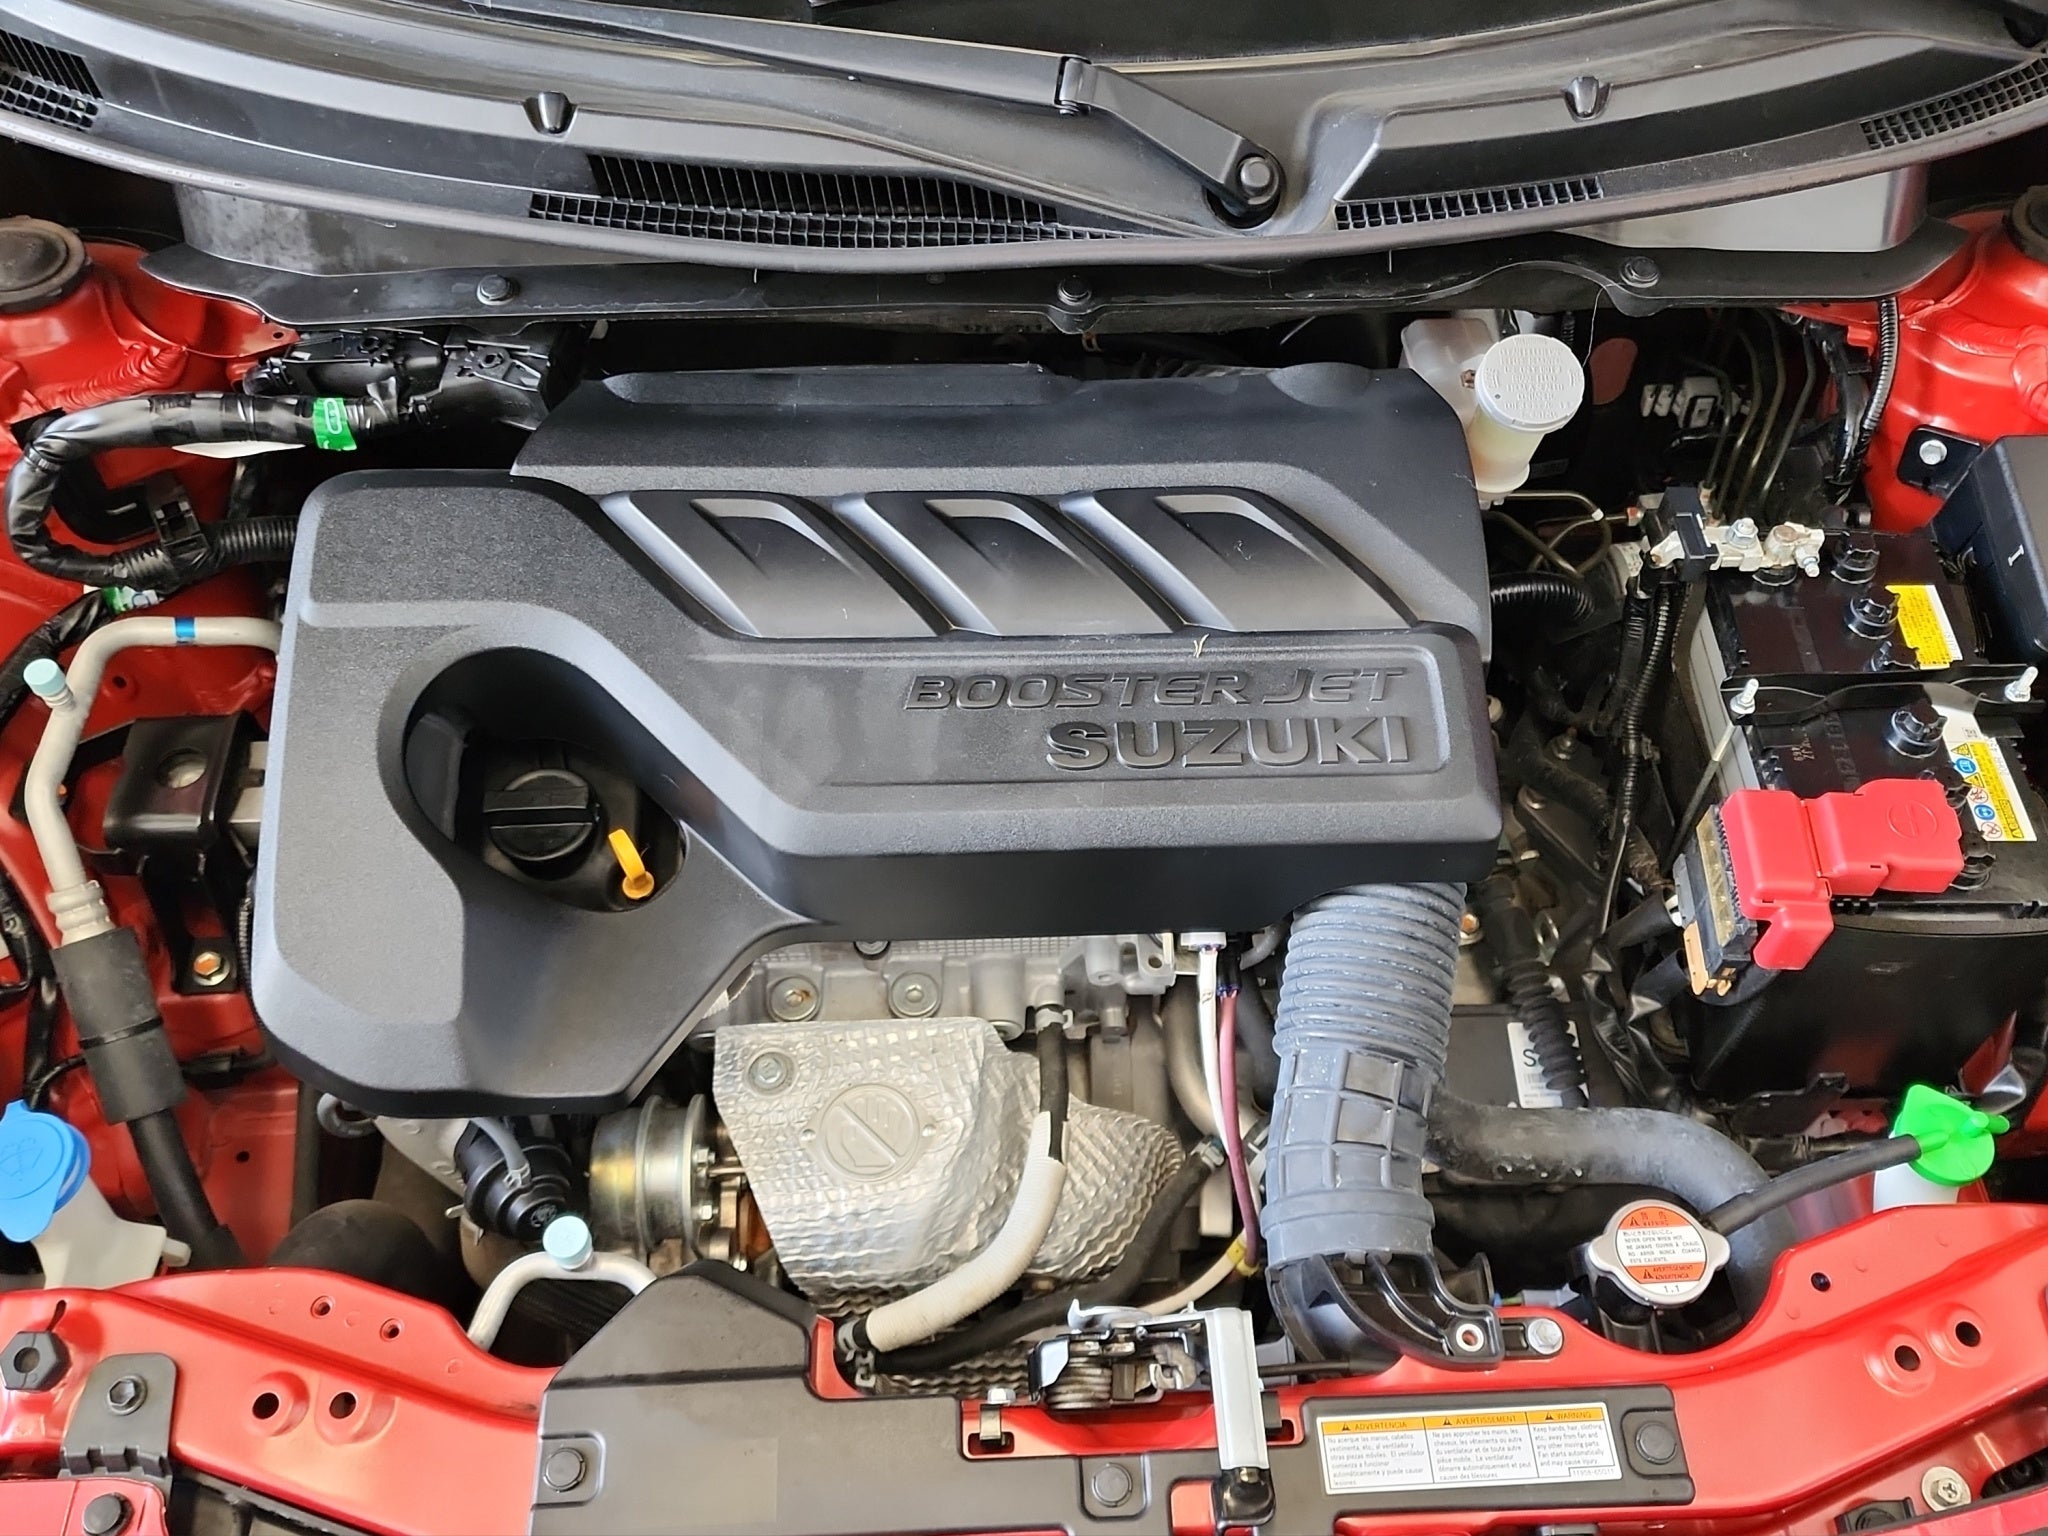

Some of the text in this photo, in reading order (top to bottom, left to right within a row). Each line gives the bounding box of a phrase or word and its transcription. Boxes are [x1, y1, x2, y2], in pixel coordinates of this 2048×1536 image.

[905, 667, 1406, 711] BOOSTER JET
[1046, 716, 1410, 771] SUZUKI
[1664, 1285, 1680, 1293] 1.1
[1455, 1414, 1516, 1424] AVERTISSEMENT
[1557, 1411, 1591, 1419] WARNING
[1354, 1420, 1406, 1430] ADVERTENCIA
